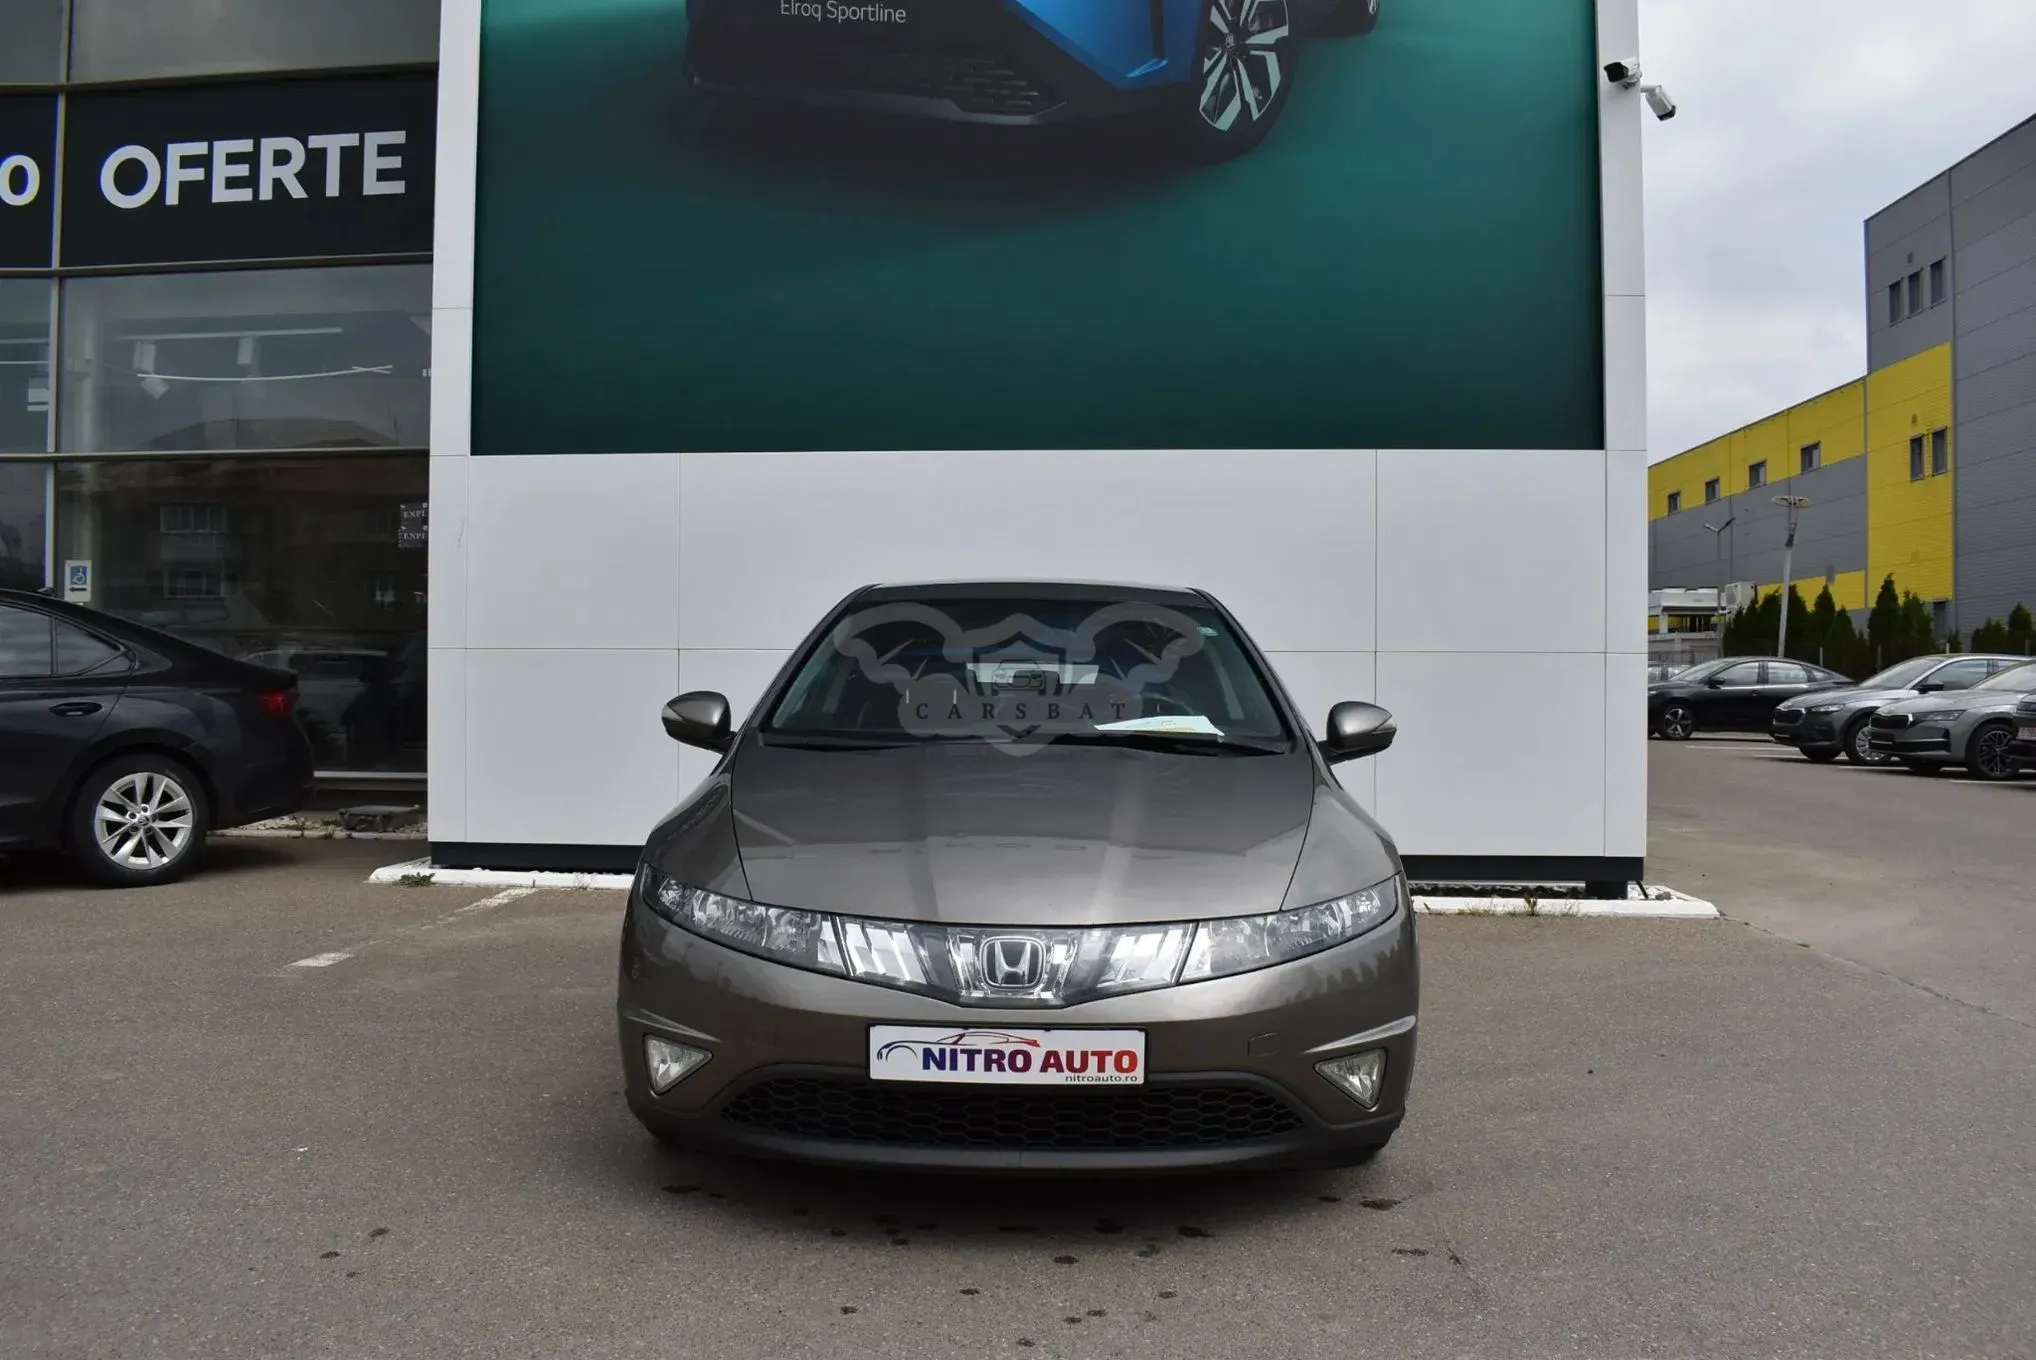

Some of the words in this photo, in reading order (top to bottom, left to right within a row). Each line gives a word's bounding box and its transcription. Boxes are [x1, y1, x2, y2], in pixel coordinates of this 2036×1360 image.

[780, 0, 822, 22] Elroq
[826, 0, 907, 24] Sportline
[100, 130, 407, 209] OFERTE
[922, 1047, 1032, 1073] NITRO
[1039, 1049, 1138, 1074] AUTO
[1065, 1074, 1138, 1083] nitroauto.ro
